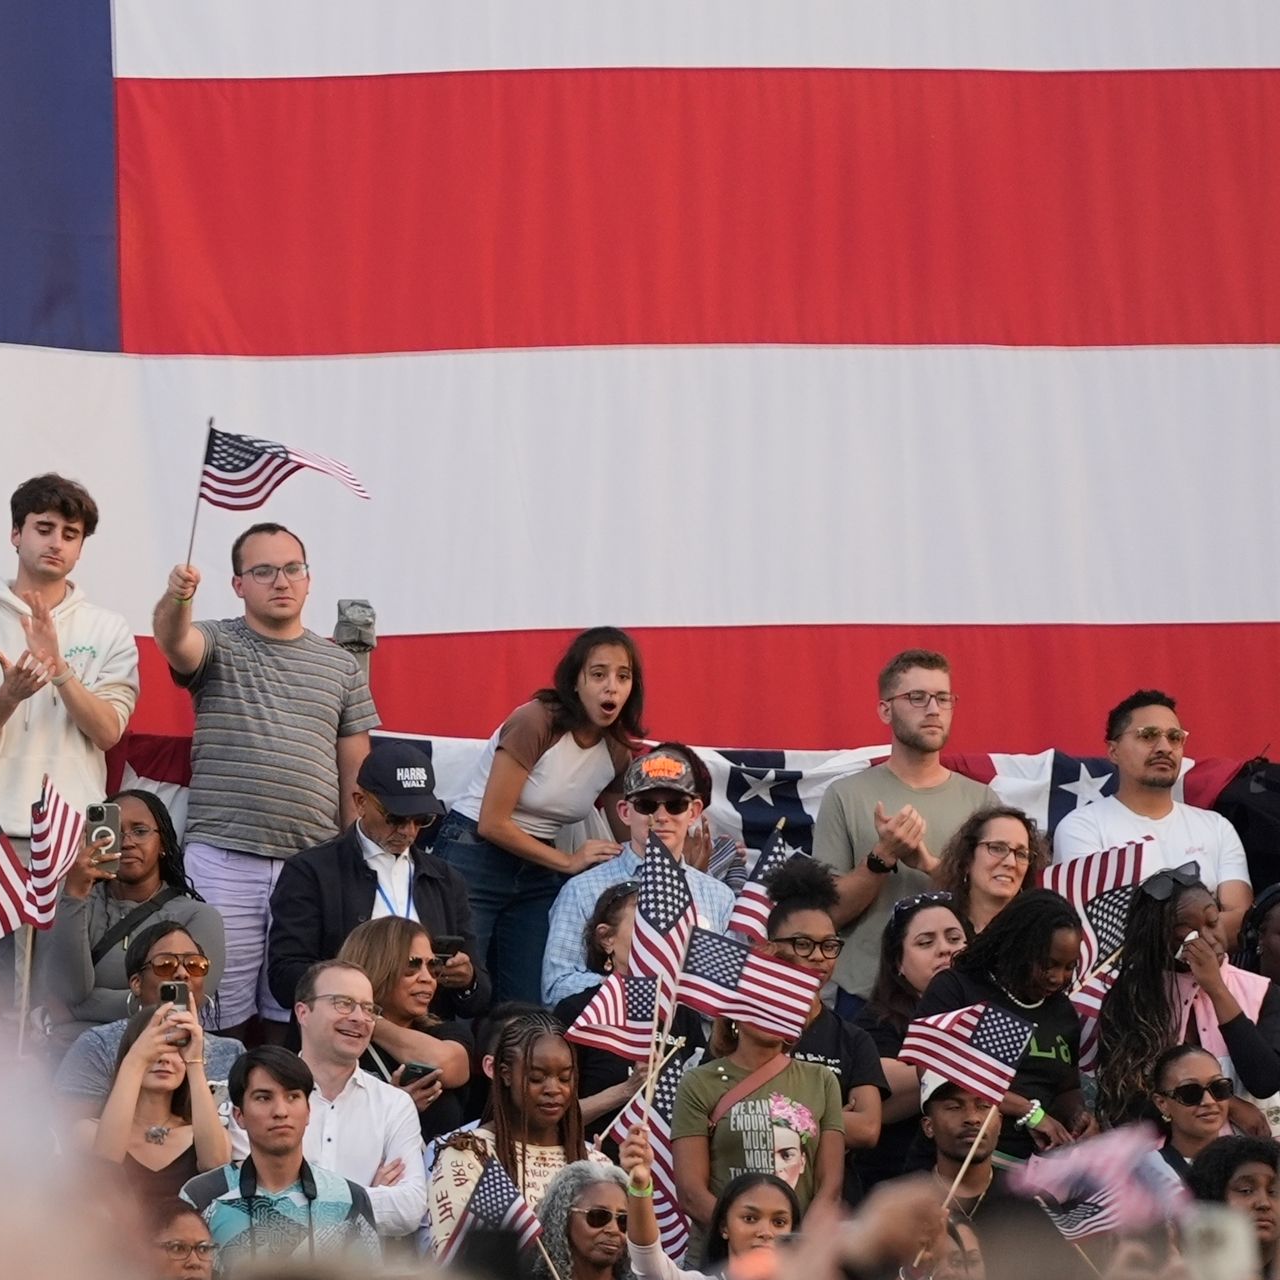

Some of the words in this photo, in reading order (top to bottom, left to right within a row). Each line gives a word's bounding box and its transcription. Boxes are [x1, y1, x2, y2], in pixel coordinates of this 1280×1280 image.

[731, 1101, 746, 1115] WE
[748, 1099, 770, 1114] CAN
[730, 1114, 772, 1131] ENDURE
[742, 1130, 774, 1149] MUCH
[745, 1150, 775, 1169] MORE
